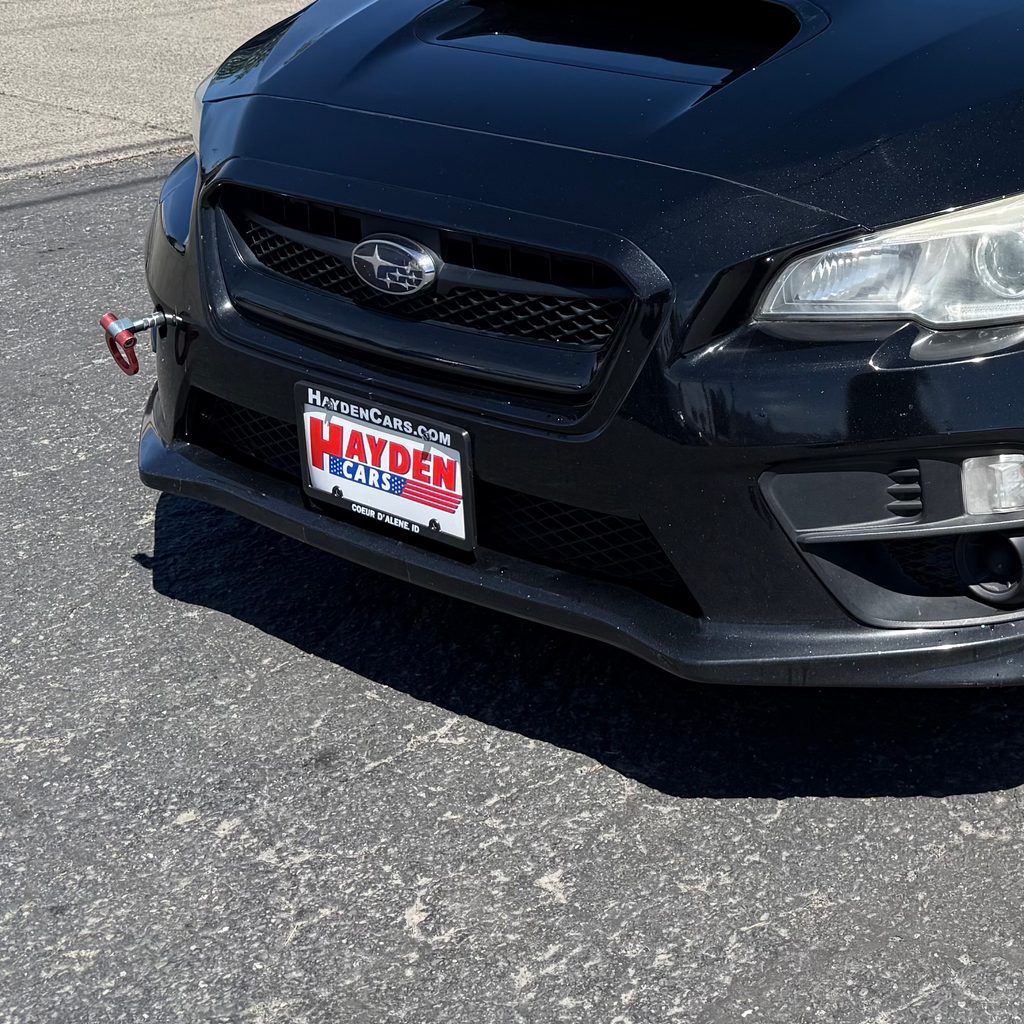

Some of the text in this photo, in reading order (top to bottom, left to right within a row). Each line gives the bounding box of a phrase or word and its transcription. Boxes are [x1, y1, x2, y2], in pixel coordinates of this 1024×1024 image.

[310, 417, 458, 492] HAYDEN
[342, 461, 391, 492] CARS
[351, 503, 376, 519] COEUR
[411, 523, 421, 534] ID
